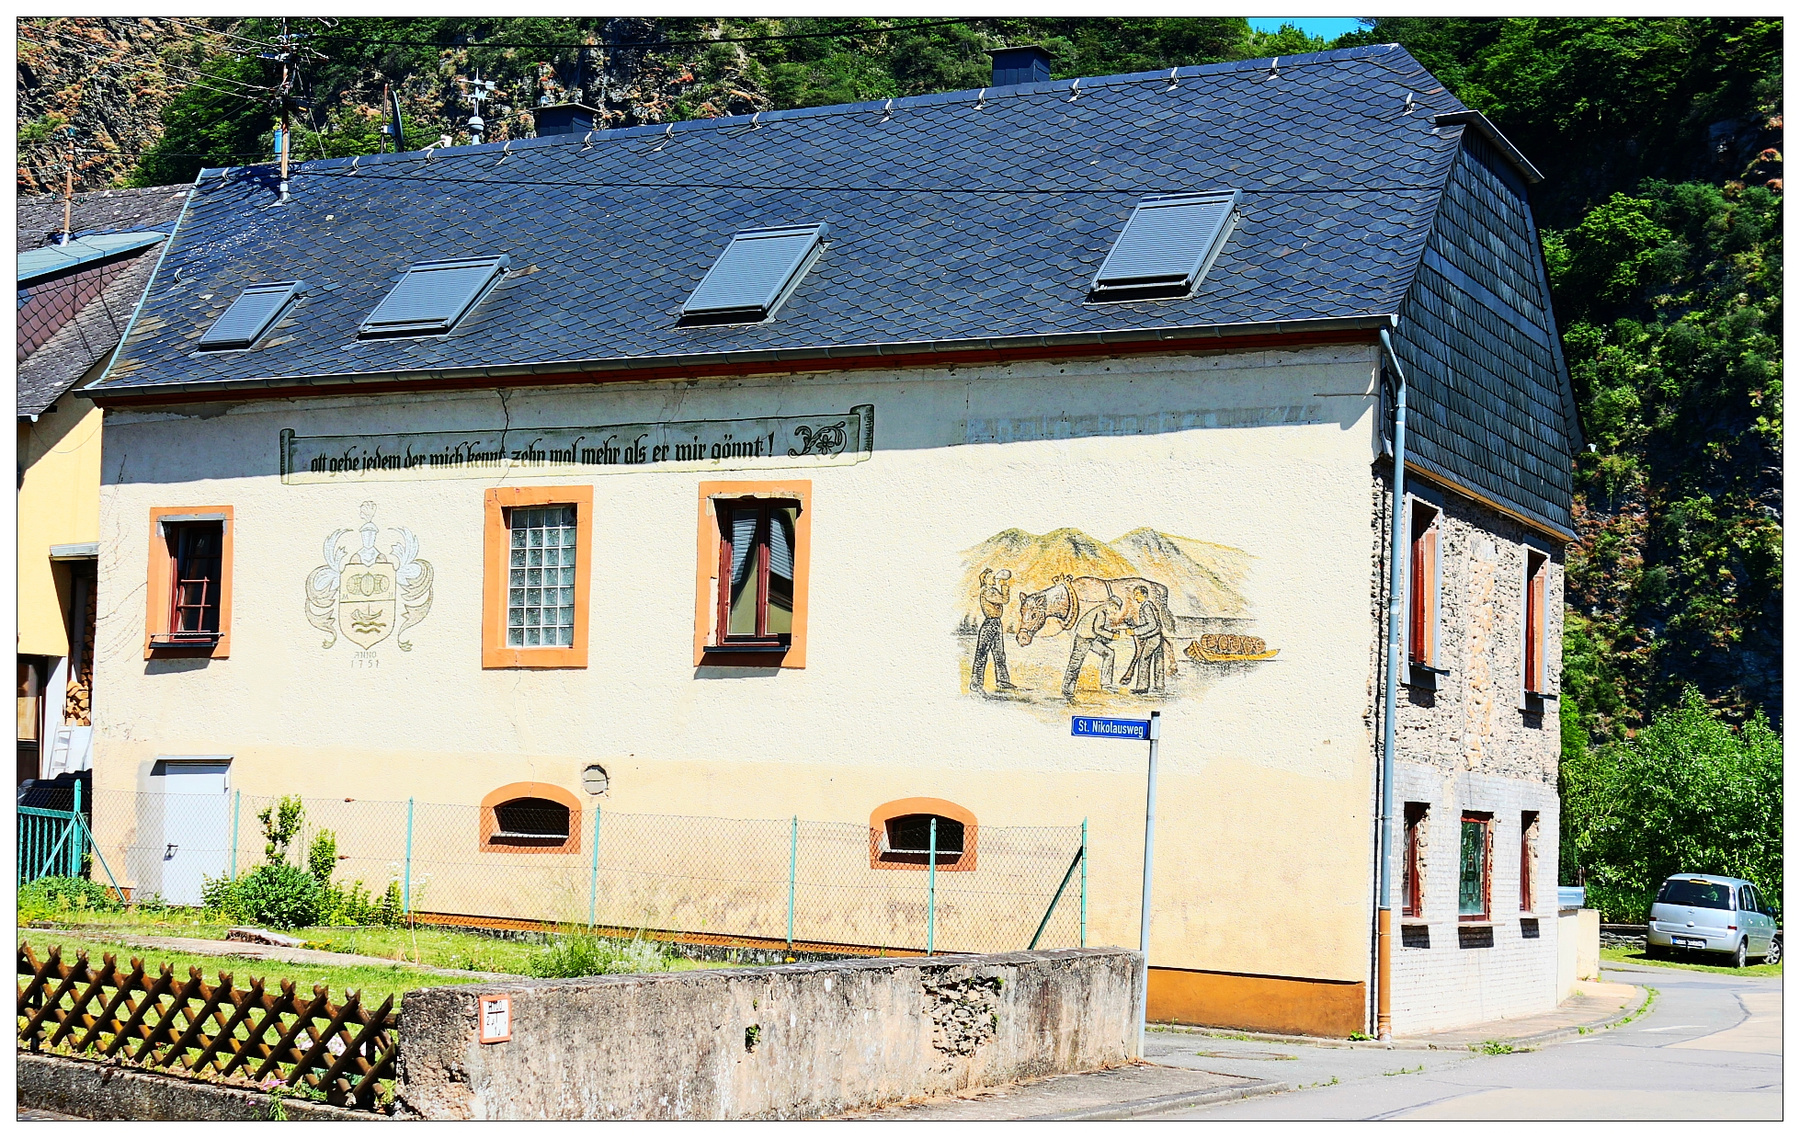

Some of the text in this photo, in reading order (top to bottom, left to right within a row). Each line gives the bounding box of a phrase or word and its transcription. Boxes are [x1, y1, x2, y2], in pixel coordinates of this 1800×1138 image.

[360, 445, 401, 477] jedem
[404, 444, 426, 469] der
[429, 441, 468, 469] mich
[509, 438, 546, 468] zehn
[549, 436, 585, 466] mal
[581, 435, 621, 465] mehr
[624, 433, 648, 464] als
[652, 444, 669, 462] er
[675, 435, 706, 461] mir
[353, 651, 377, 659] ANNO
[350, 659, 380, 669] 1751
[1078, 719, 1144, 738] St. Nikolausweg
